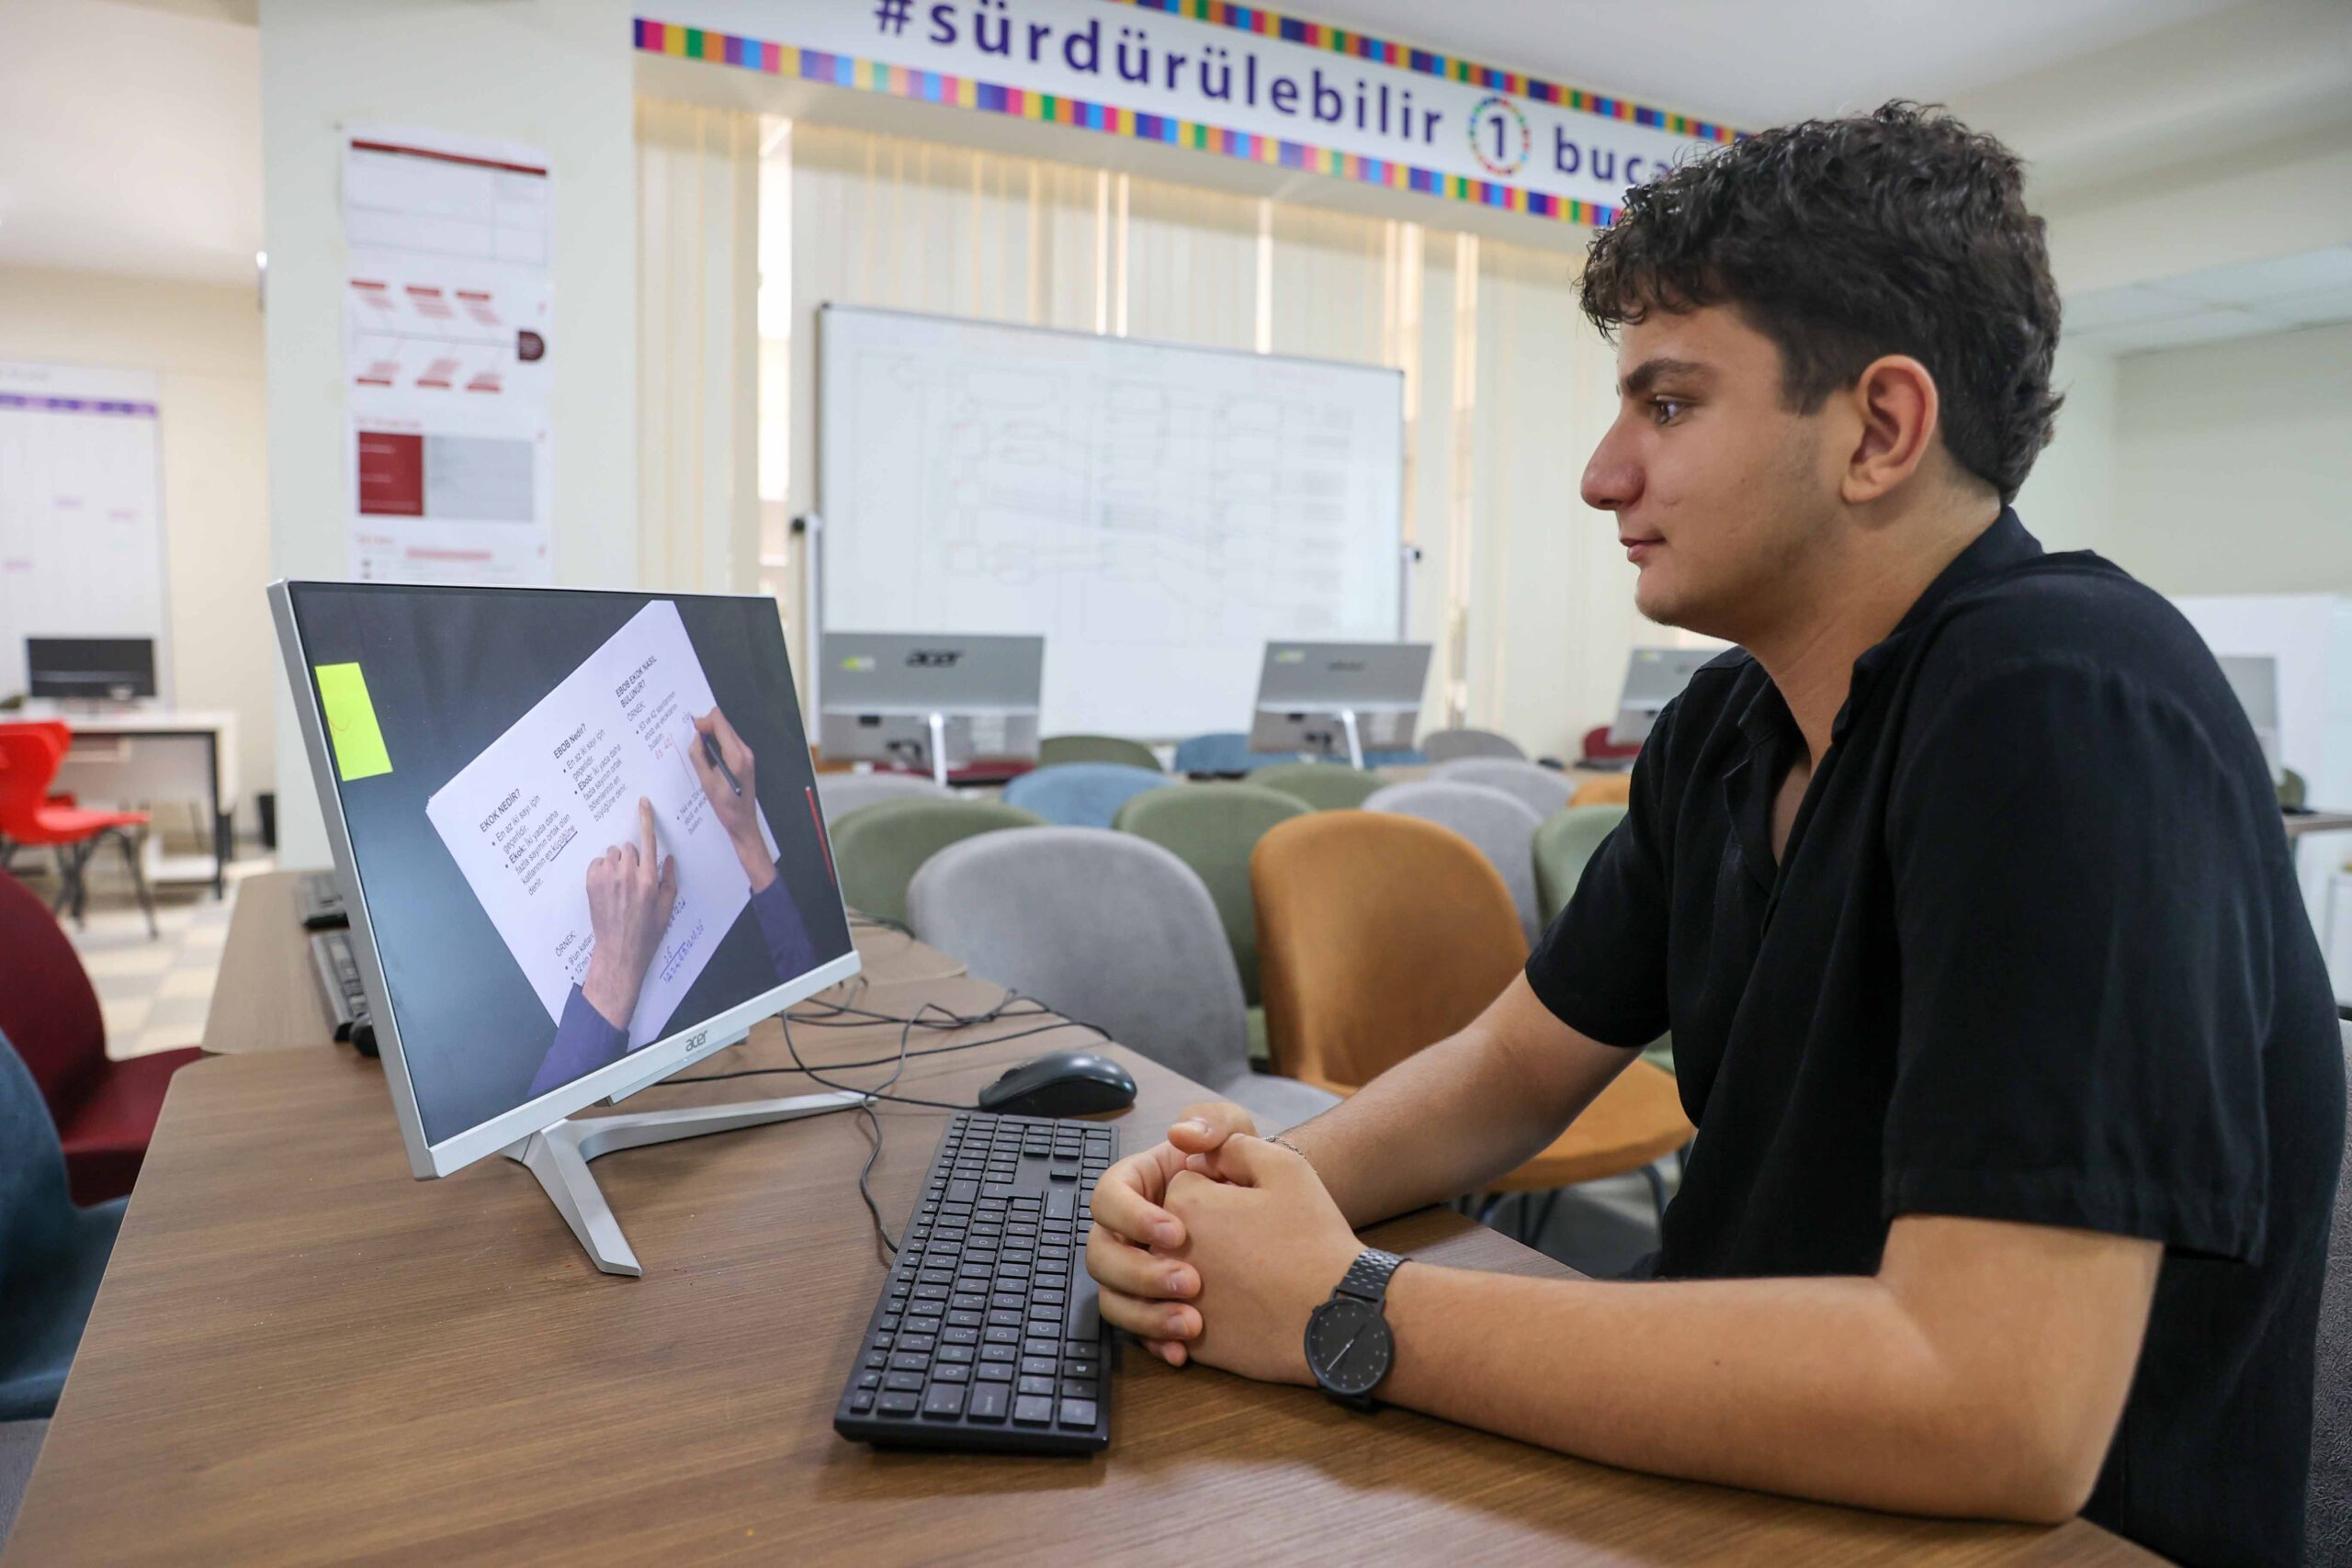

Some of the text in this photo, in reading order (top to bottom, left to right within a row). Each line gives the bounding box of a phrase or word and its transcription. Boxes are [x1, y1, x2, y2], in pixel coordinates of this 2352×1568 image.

[875, 0, 1442, 143] #sürdürülebilir
[616, 680, 630, 697] EBOB
[629, 667, 643, 684] EKOK
[553, 723, 586, 759] EBOB Nedir?
[567, 759, 575, 769] En
[575, 753, 582, 762] az
[480, 788, 522, 833] EKOK NEDİR?
[496, 795, 540, 841] En az iki sayı için
[503, 825, 528, 854] geçerlidir.
[509, 844, 527, 864] Ekok:
[533, 823, 546, 841] yada
[545, 810, 559, 827] daha
[515, 814, 571, 874] fazla sayının ortak olan
[522, 857, 546, 885] katlarının
[545, 850, 553, 860] en
[528, 877, 543, 896] denir.
[685, 1030, 707, 1052] acer
